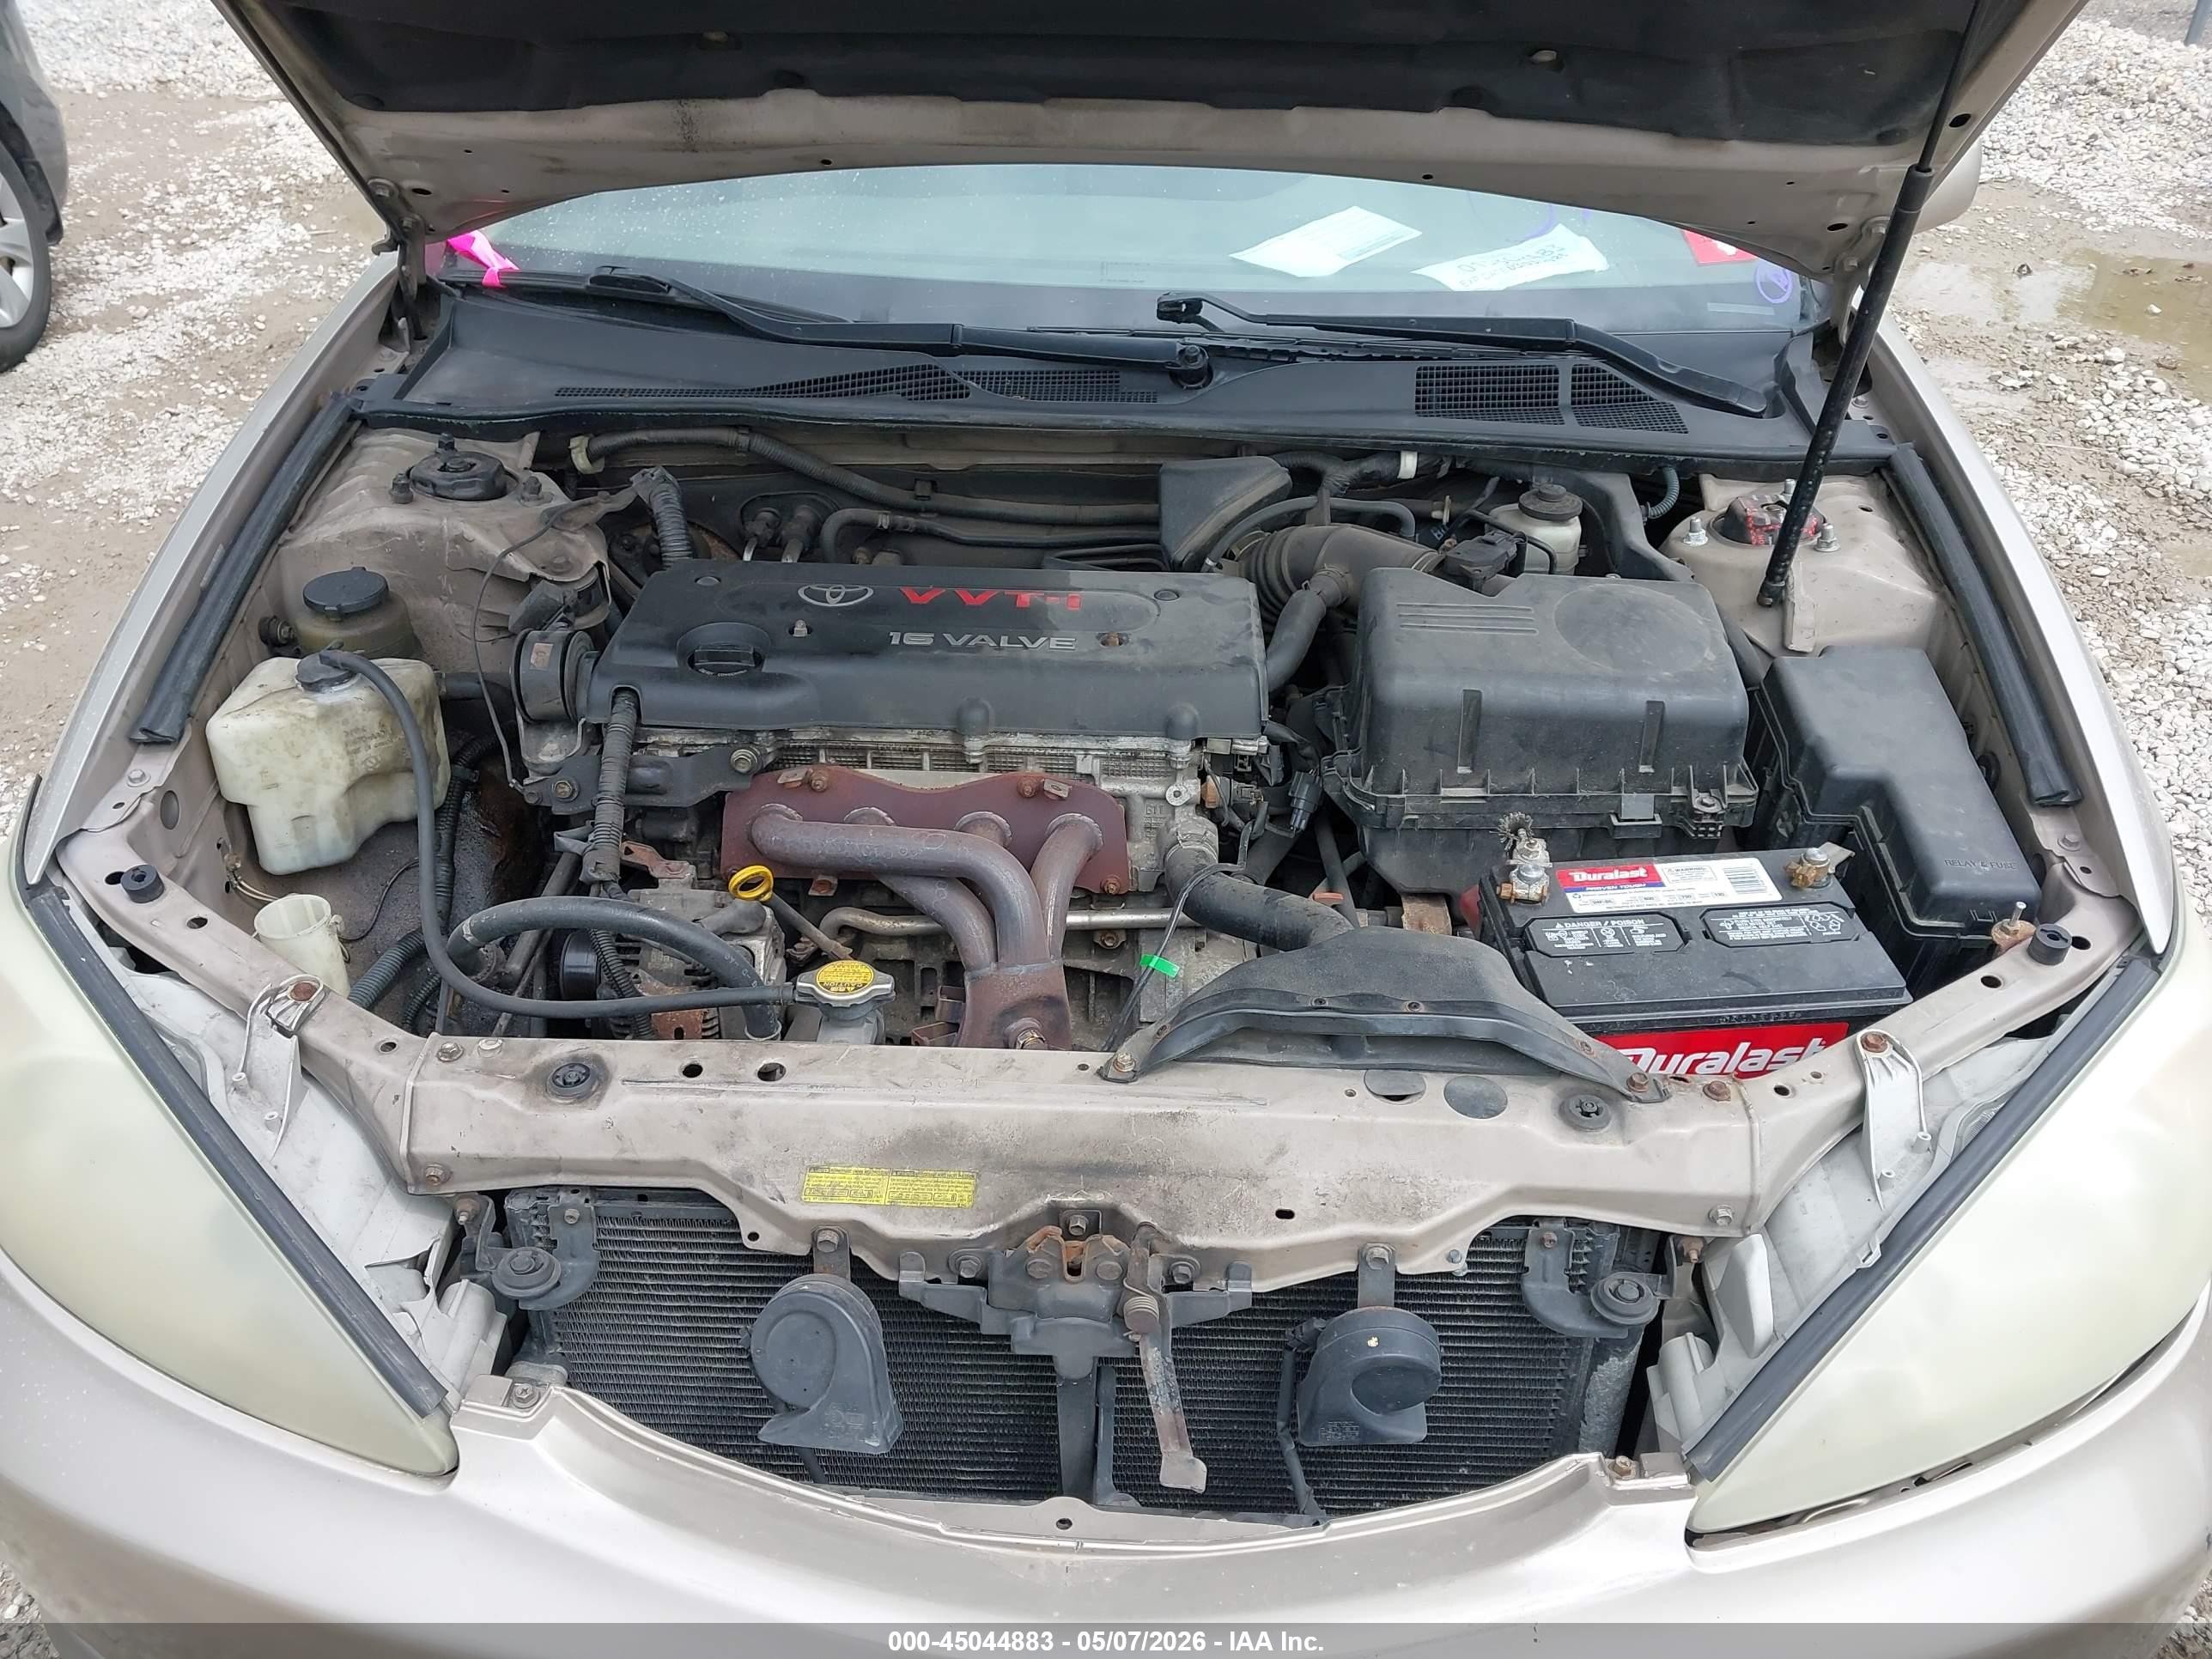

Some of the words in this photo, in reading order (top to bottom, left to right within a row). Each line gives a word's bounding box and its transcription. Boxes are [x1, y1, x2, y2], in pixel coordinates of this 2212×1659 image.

[889, 631, 934, 646] 16
[943, 633, 1076, 650] VALVE
[1944, 859, 1977, 869] RELAY
[1990, 861, 2019, 871] FUSE
[1568, 866, 1649, 883] Duralast
